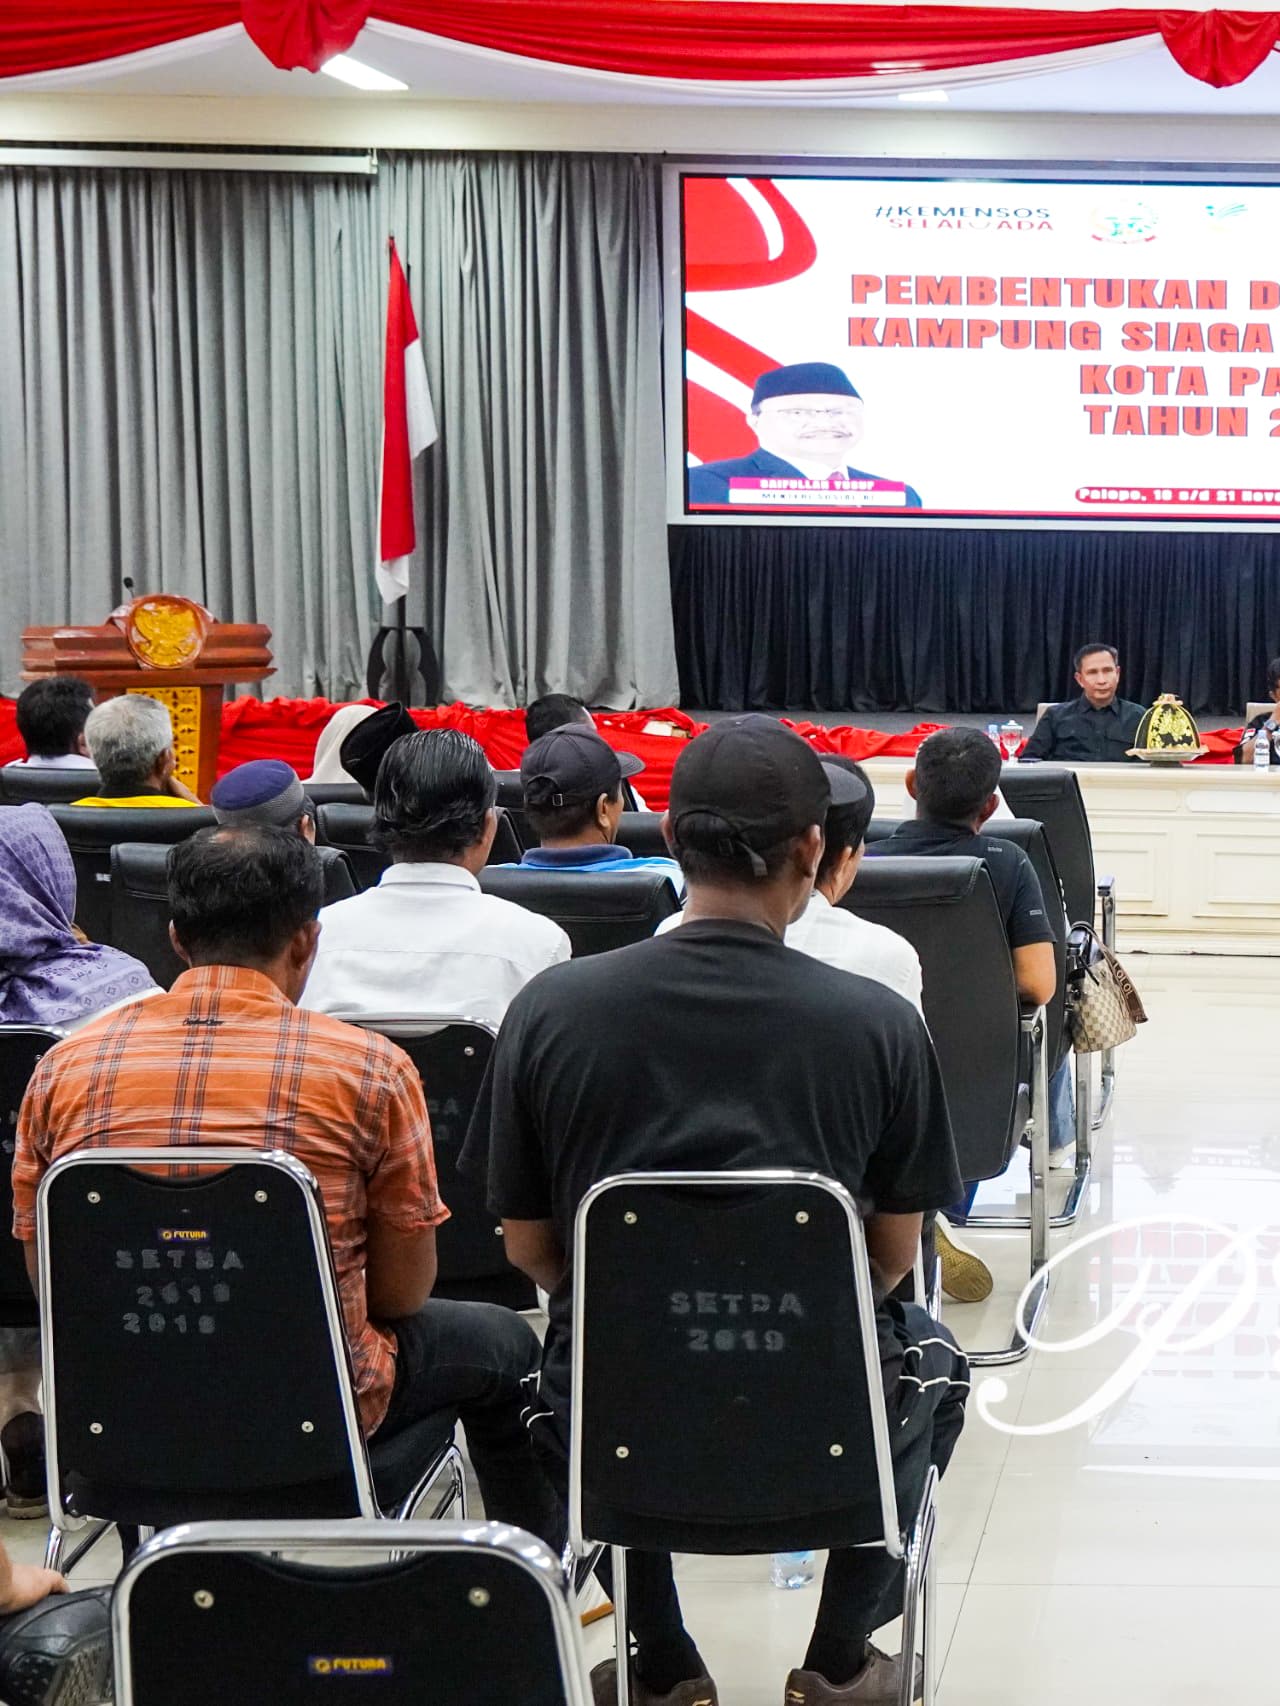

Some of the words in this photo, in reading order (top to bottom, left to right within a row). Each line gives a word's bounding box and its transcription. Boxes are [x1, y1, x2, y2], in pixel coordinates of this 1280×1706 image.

[852, 275, 1228, 310] PEMBENTUKAN
[848, 317, 1102, 351] KAMPUNG
[1121, 322, 1274, 353] SIAGA
[1080, 365, 1209, 396] KOTA
[1083, 405, 1249, 436] TAHUN
[669, 1291, 804, 1317] SETDA
